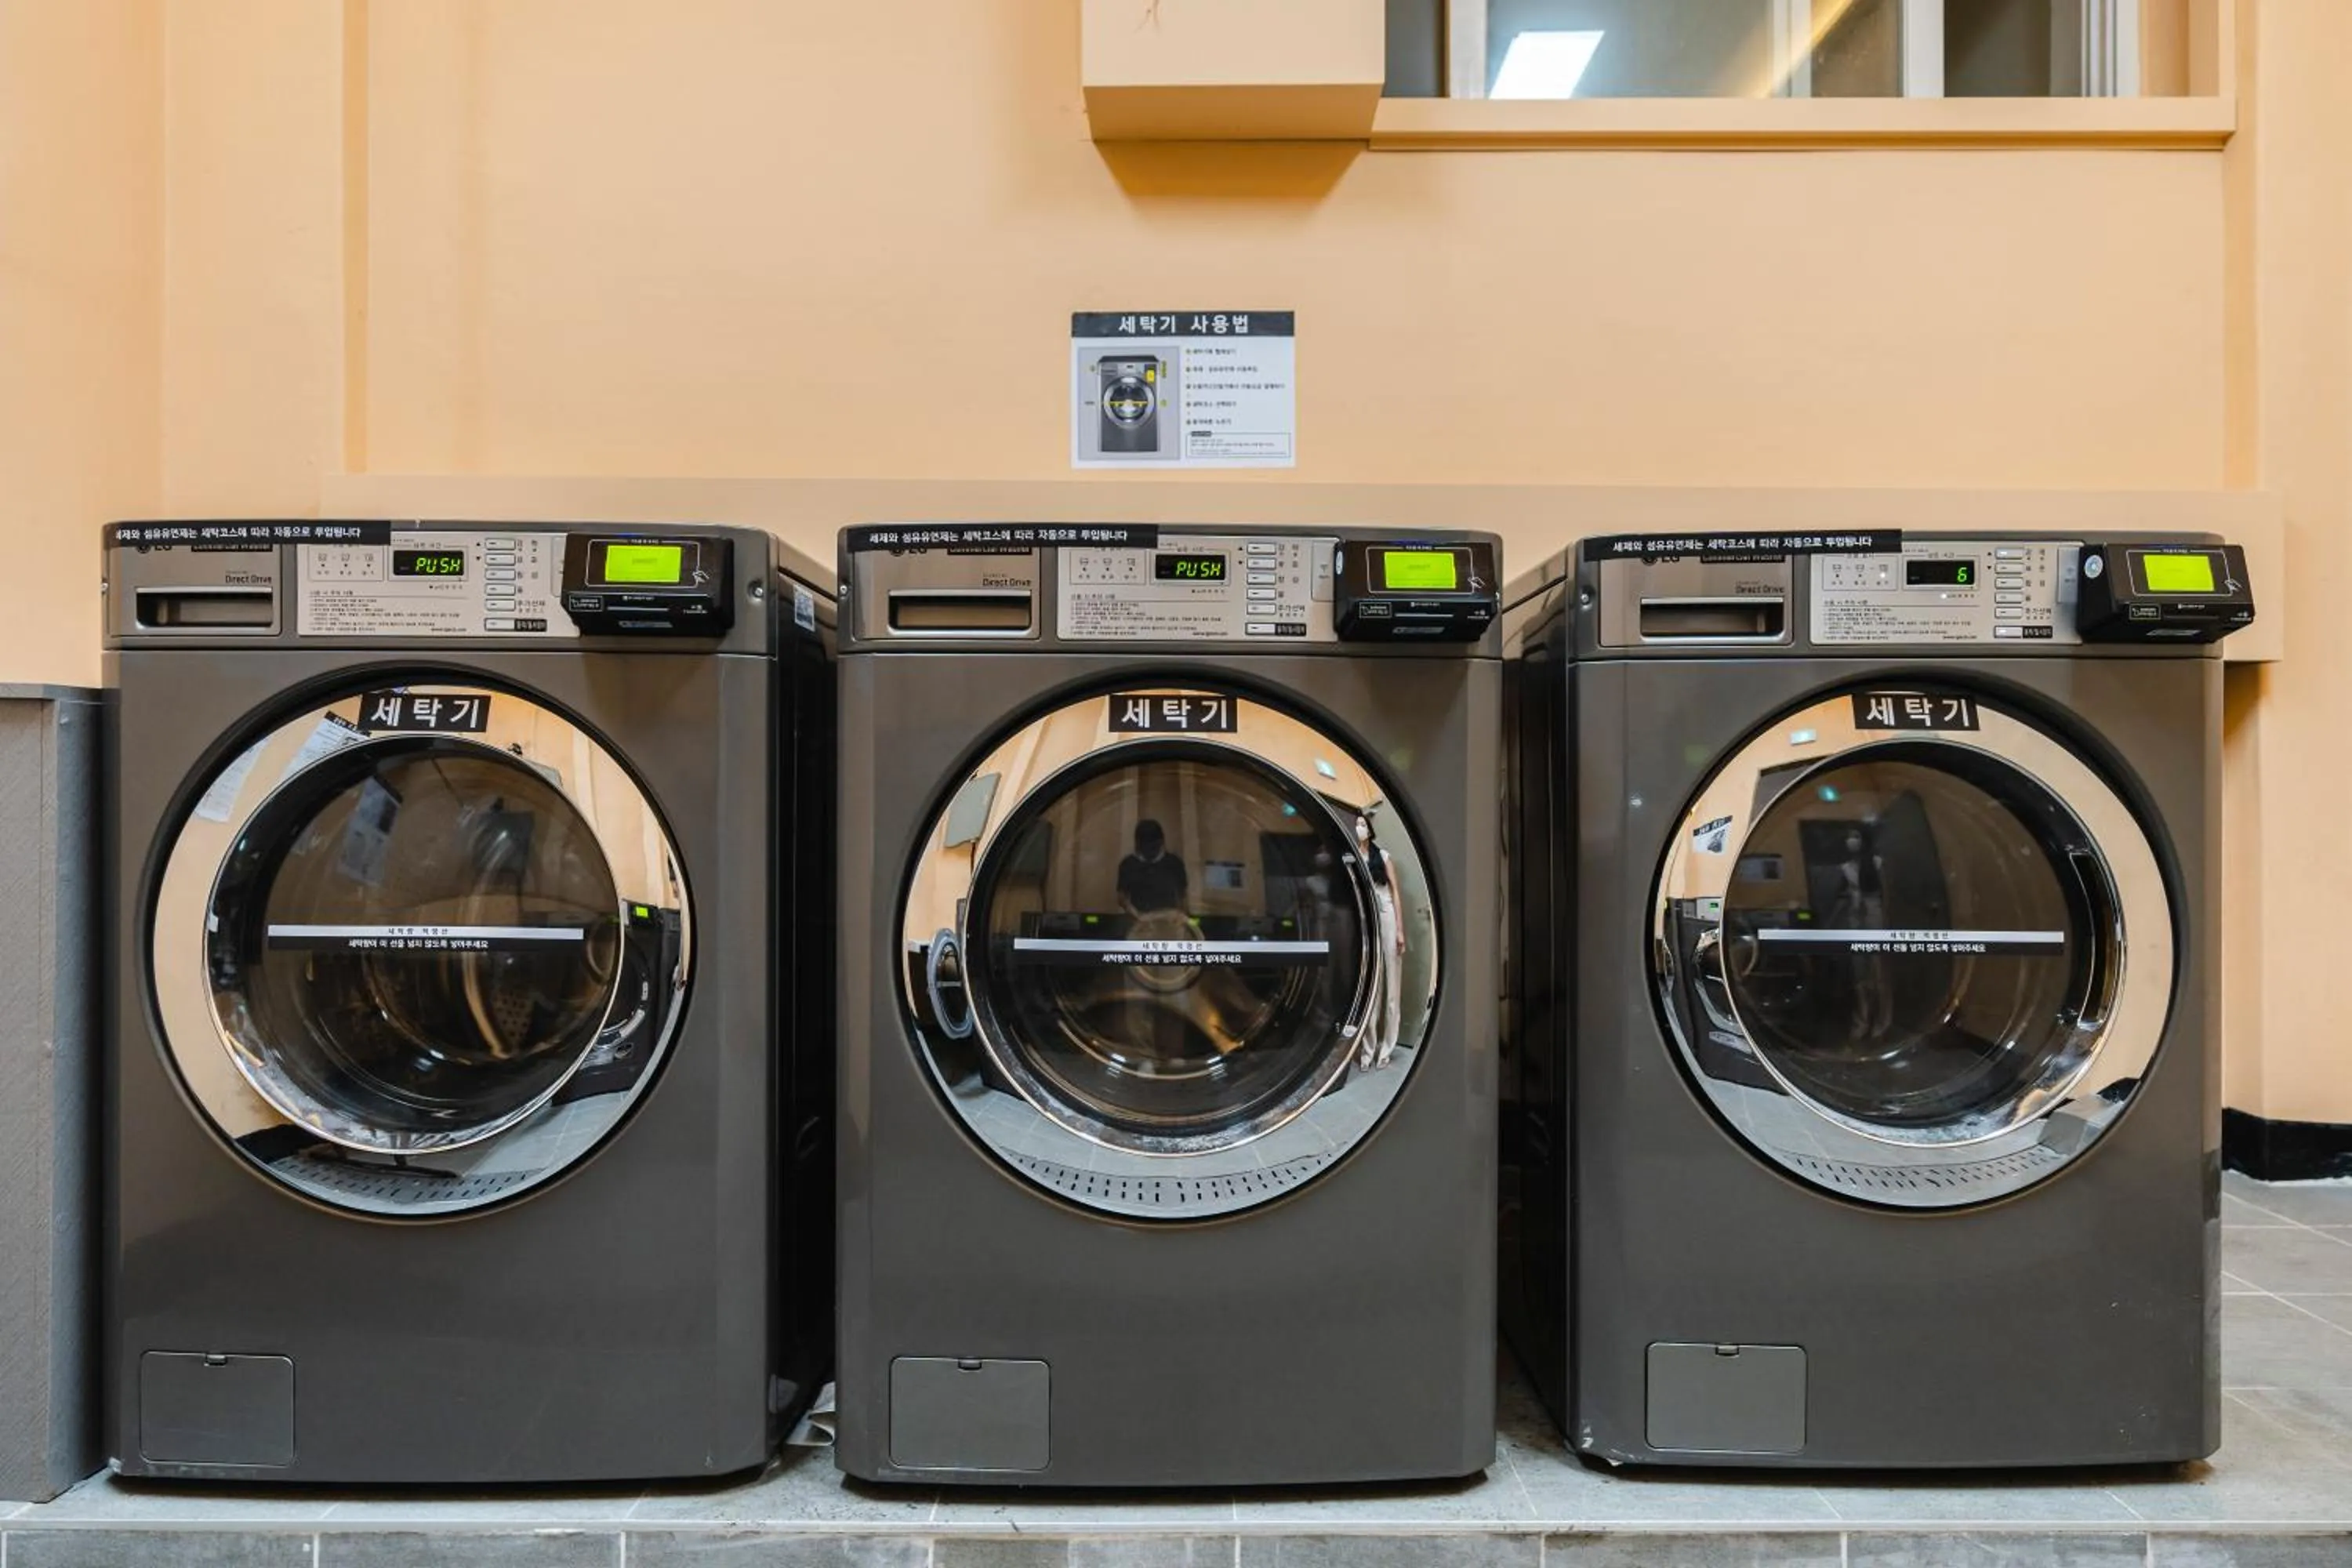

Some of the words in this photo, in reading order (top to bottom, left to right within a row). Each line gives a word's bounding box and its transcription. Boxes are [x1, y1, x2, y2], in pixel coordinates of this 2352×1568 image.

[1119, 314, 1176, 333] 세탁기
[1191, 314, 1248, 333] 사용법
[250, 526, 270, 538] 따라
[274, 526, 310, 538] 자동으로
[315, 526, 361, 538] 투입됩니다
[1014, 529, 1034, 541] 따라
[1038, 529, 1076, 541] 자동으로
[1081, 529, 1127, 541] 투입됩니다
[1759, 537, 1780, 549] 따라
[1783, 536, 1822, 548] 자동으로
[1826, 535, 1872, 548] 투입됩니다
[415, 557, 461, 573] PUSH
[1177, 561, 1221, 578] PUSH
[225, 574, 249, 584] Direct
[1956, 567, 1968, 583] 6
[371, 698, 480, 728] 세탁기
[1121, 699, 1227, 728] 세탁기
[1867, 697, 1969, 727] 세탁기
